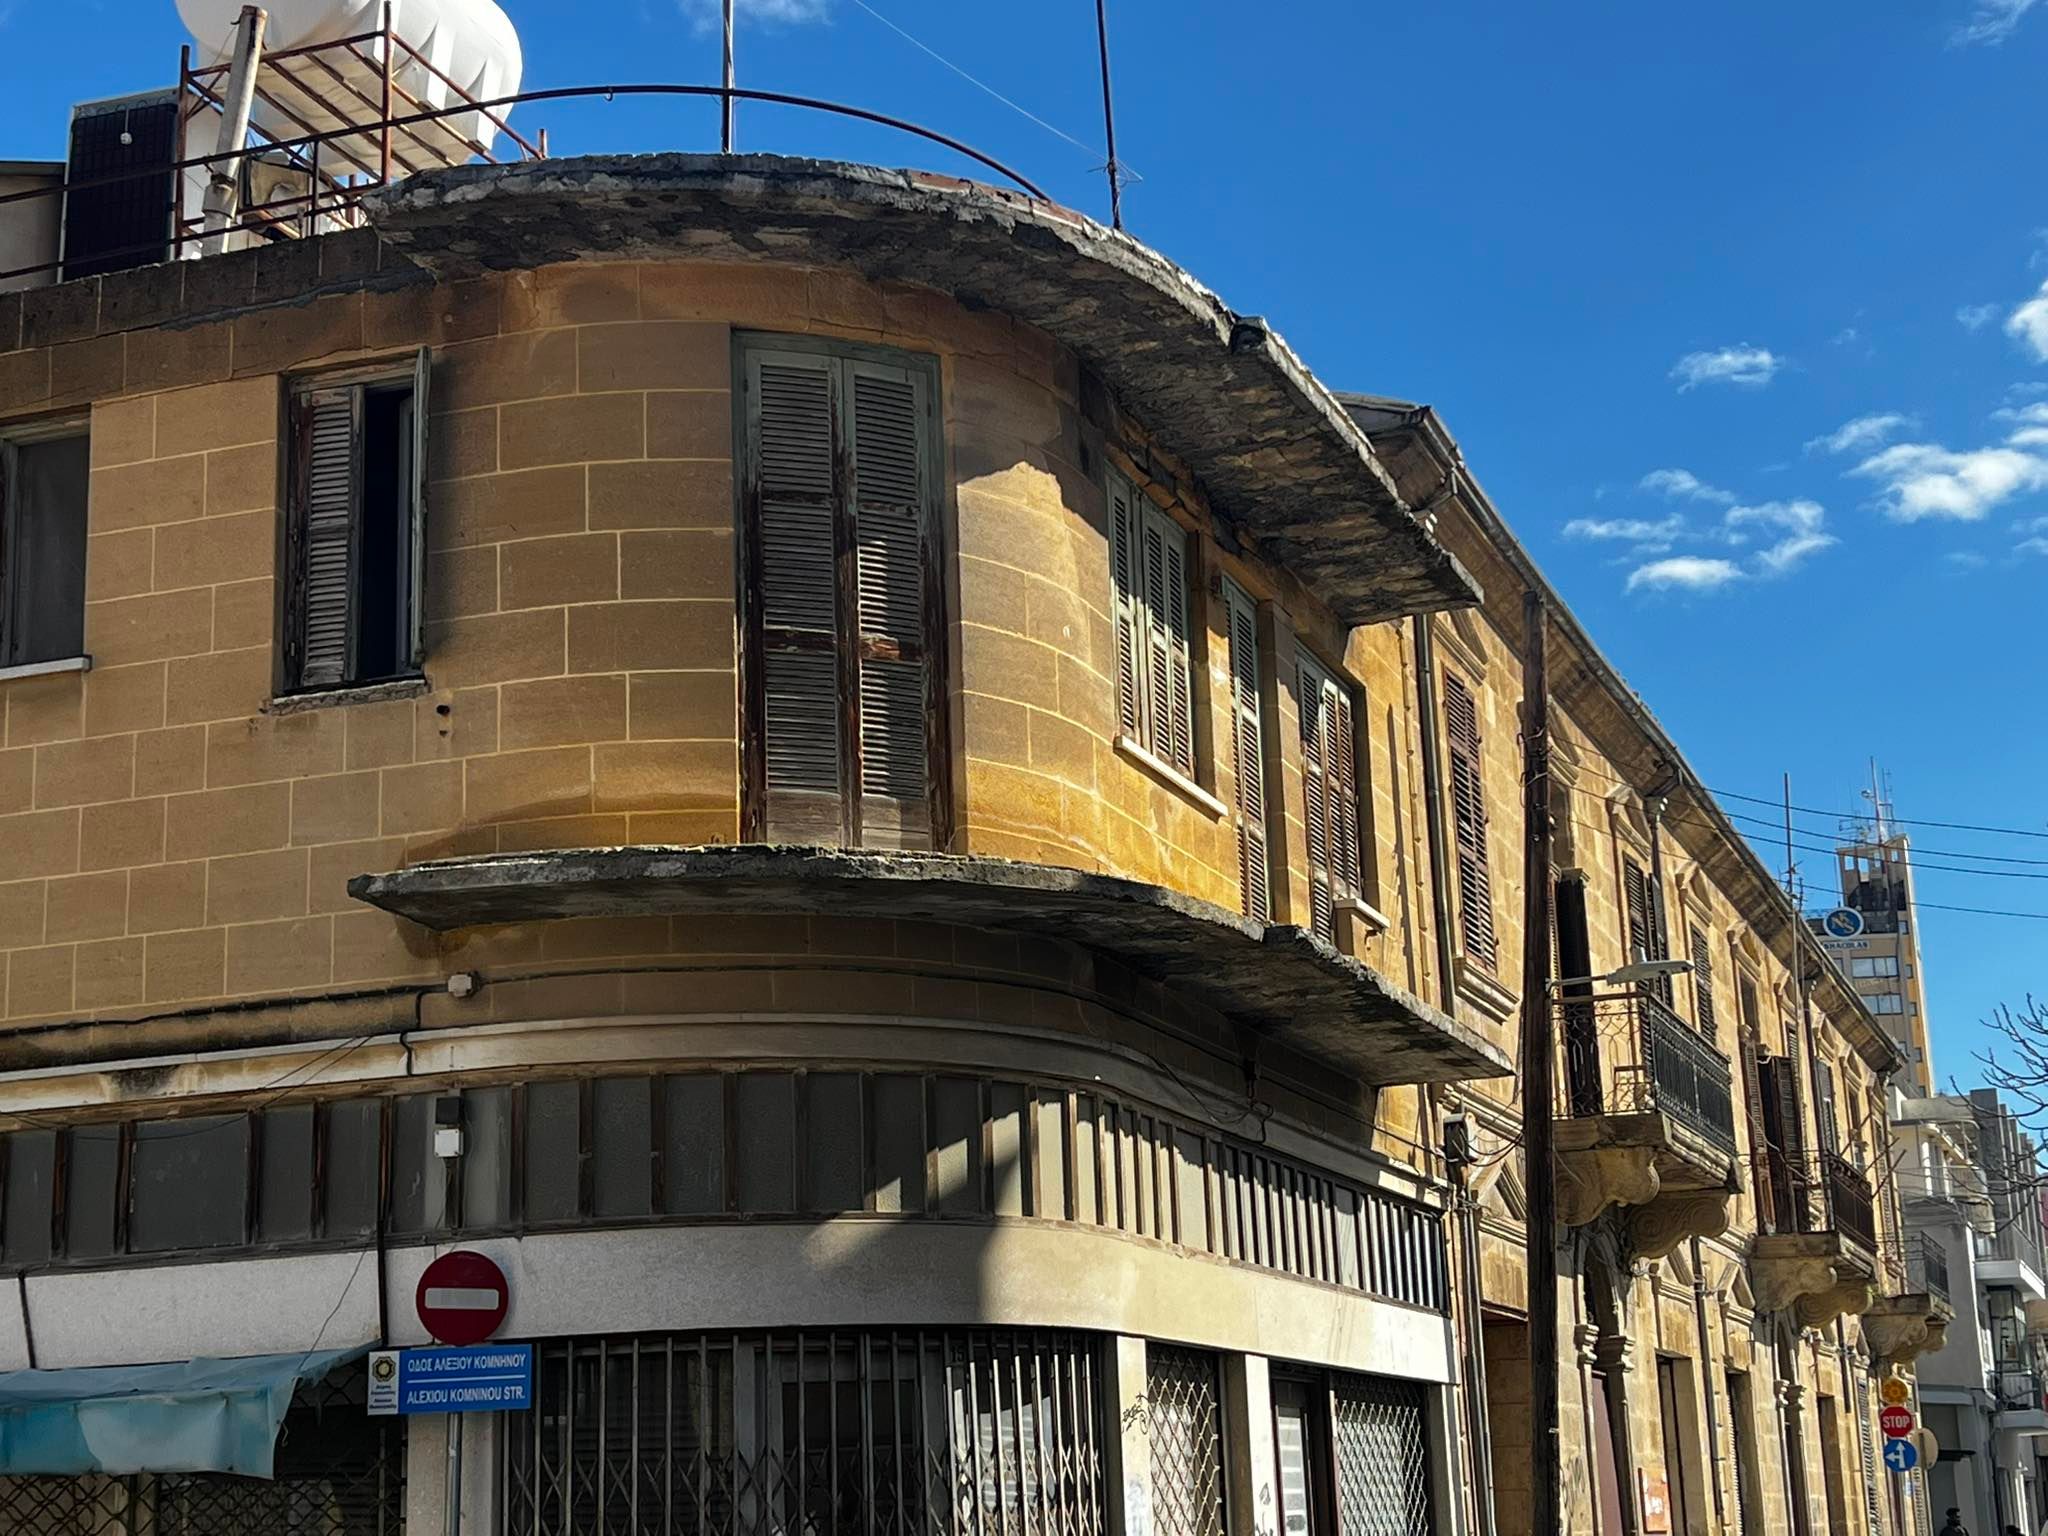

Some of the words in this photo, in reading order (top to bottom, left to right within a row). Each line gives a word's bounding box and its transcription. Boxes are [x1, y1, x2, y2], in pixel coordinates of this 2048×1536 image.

[408, 1358, 433, 1372] ΟΔΟΣ
[434, 1356, 473, 1371] ΑΛΕΞΙΟΥ
[474, 1354, 526, 1369] ΚΟΜΝΗΝΟΥ
[406, 1389, 448, 1405] ALEXIOU
[450, 1387, 502, 1402] KOMNINOU
[503, 1386, 526, 1400] STR.
[1882, 1415, 1910, 1428] STOP
